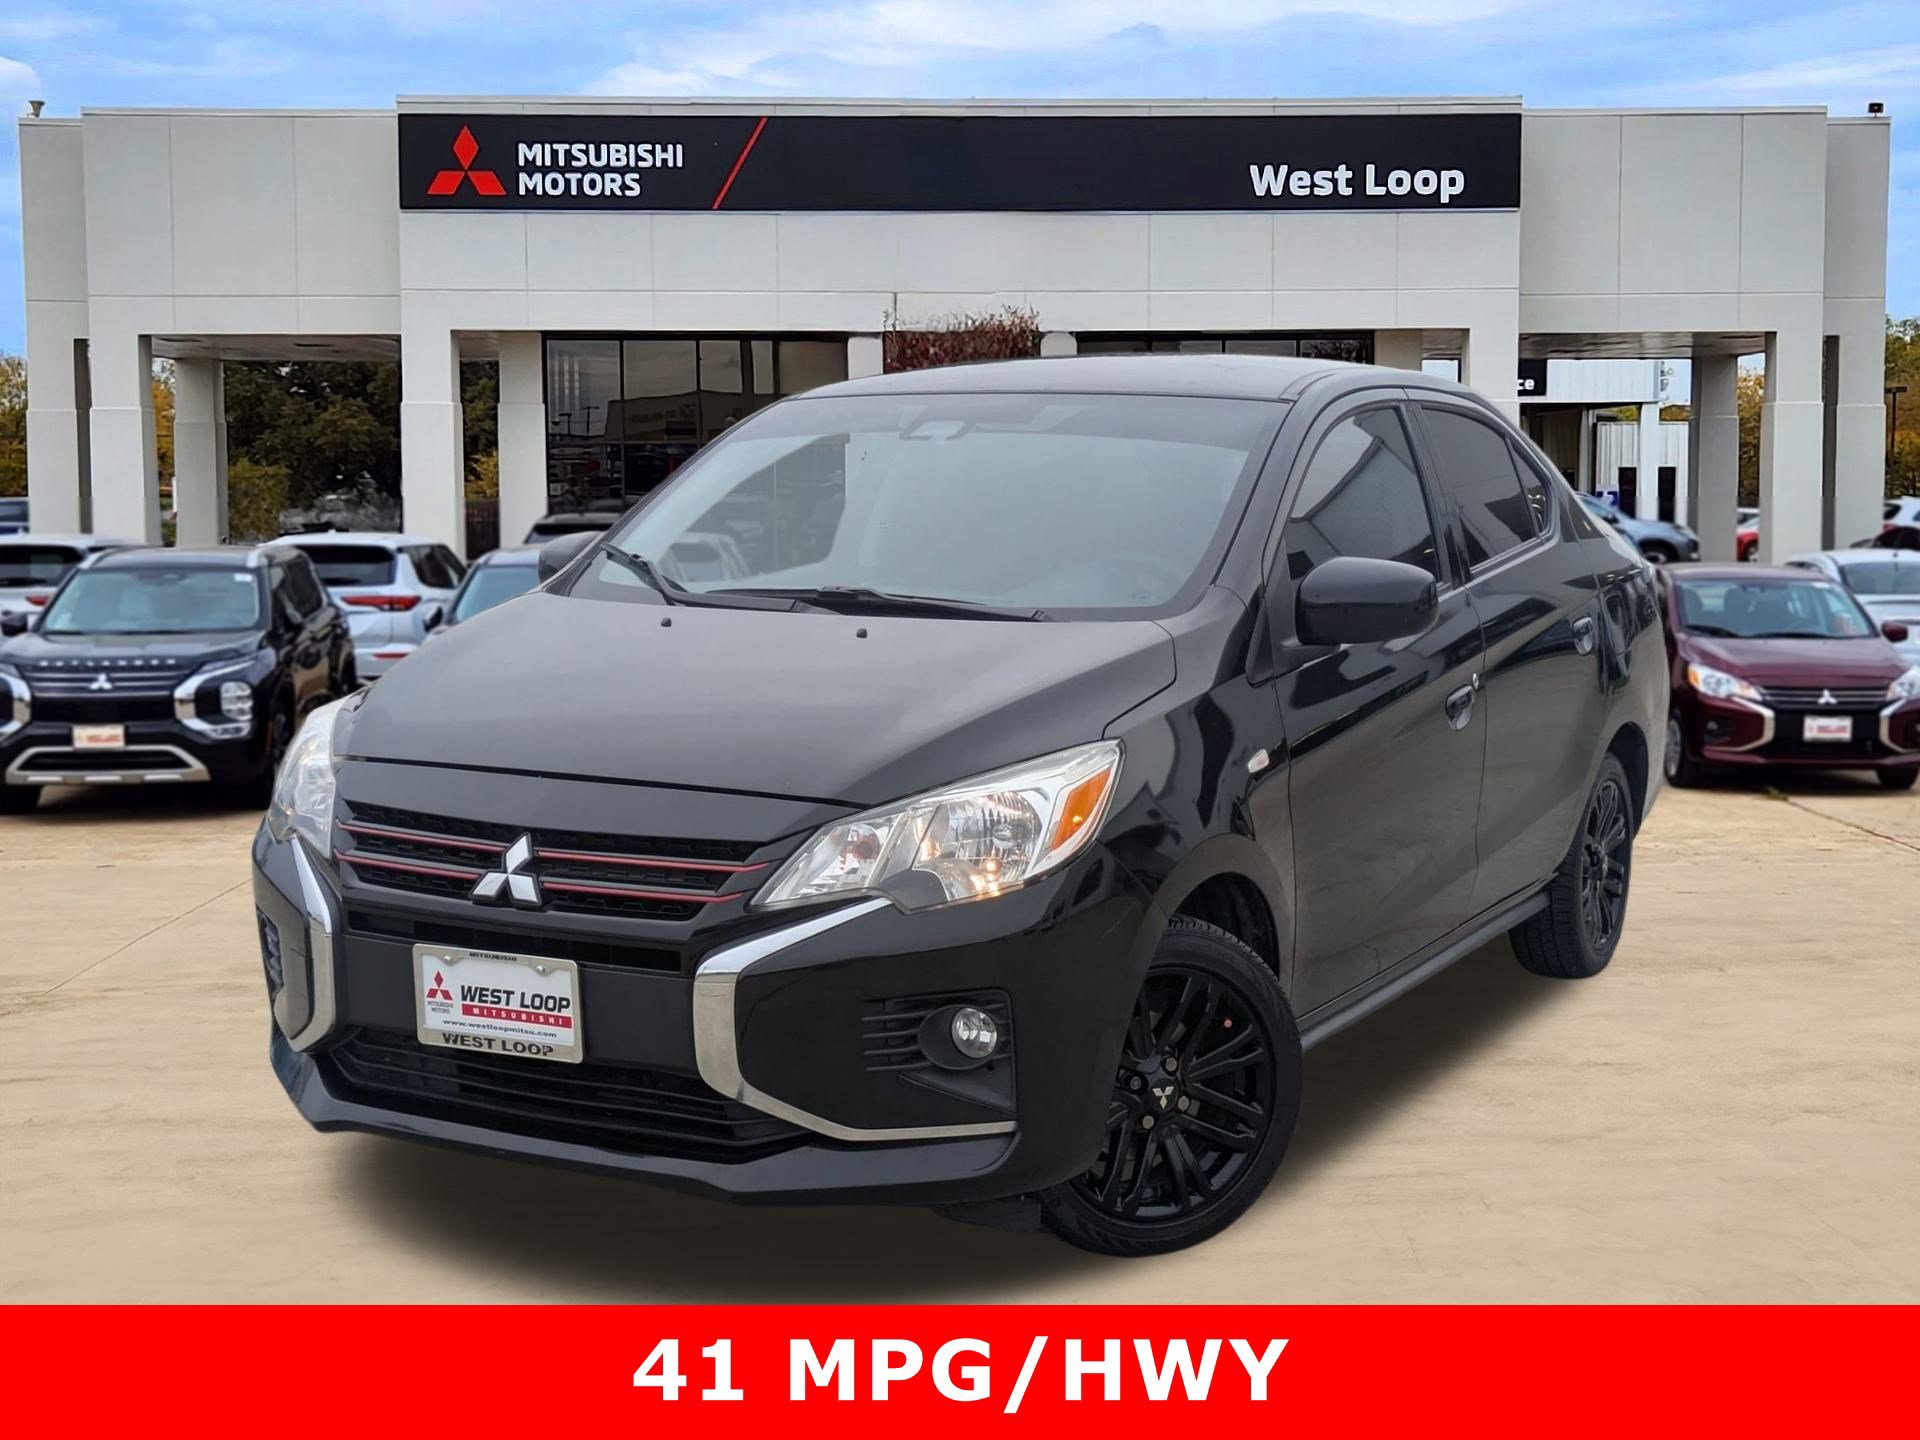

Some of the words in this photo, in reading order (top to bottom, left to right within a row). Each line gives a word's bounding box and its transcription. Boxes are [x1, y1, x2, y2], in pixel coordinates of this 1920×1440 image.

[518, 142, 683, 168] MITSUBISHI
[518, 172, 641, 197] MOTORS
[1249, 163, 1353, 197] West
[1365, 163, 1466, 204] Loop
[460, 984, 515, 1007] WEST
[519, 991, 571, 1013] LOOP
[442, 1018, 557, 1038] www.westloopmitsu.com
[472, 1007, 563, 1026] MITSUBISHI
[442, 1032, 496, 1050] WEST
[501, 1039, 554, 1056] LOOP
